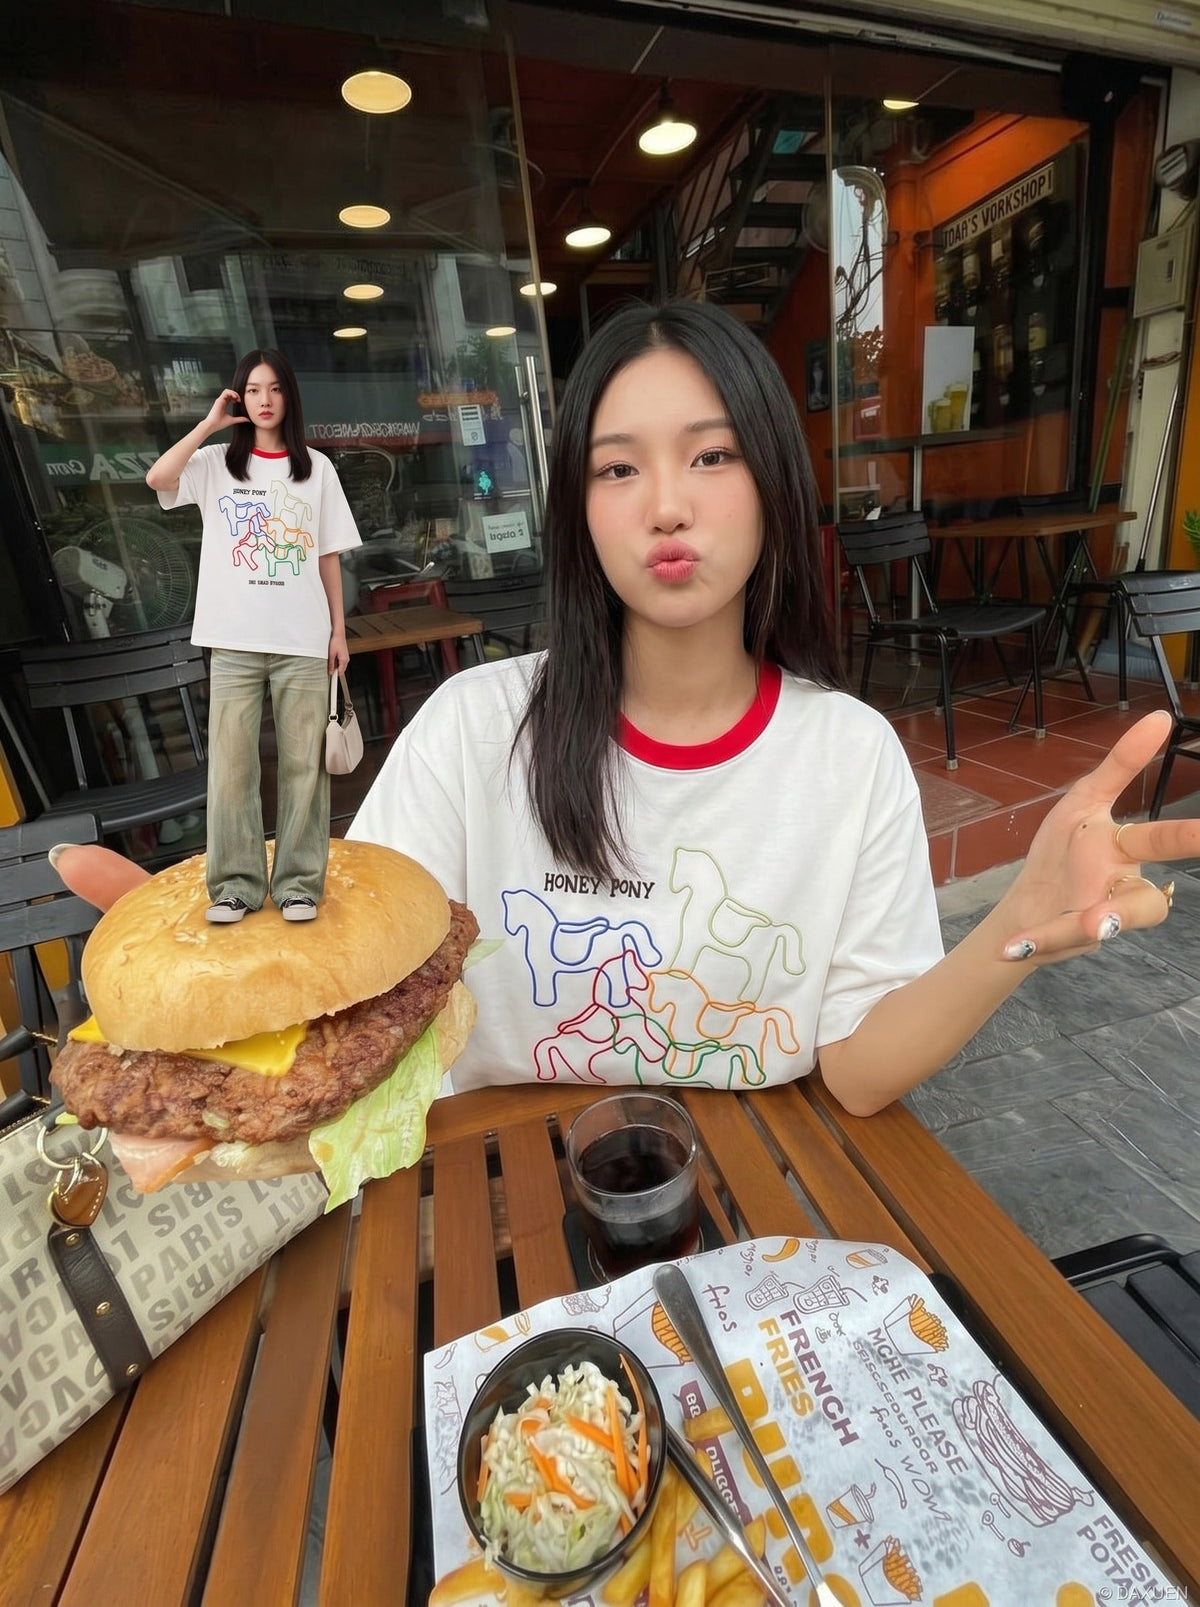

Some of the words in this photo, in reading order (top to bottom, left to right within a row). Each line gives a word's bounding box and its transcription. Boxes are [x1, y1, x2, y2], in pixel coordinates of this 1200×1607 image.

[544, 872, 601, 896] HONEY
[609, 877, 656, 900] PONY
[129, 1196, 243, 1301] PARIS
[758, 1317, 818, 1418] FRIES
[780, 1309, 861, 1447] FRENCH
[902, 1387, 968, 1476] PLEASE
